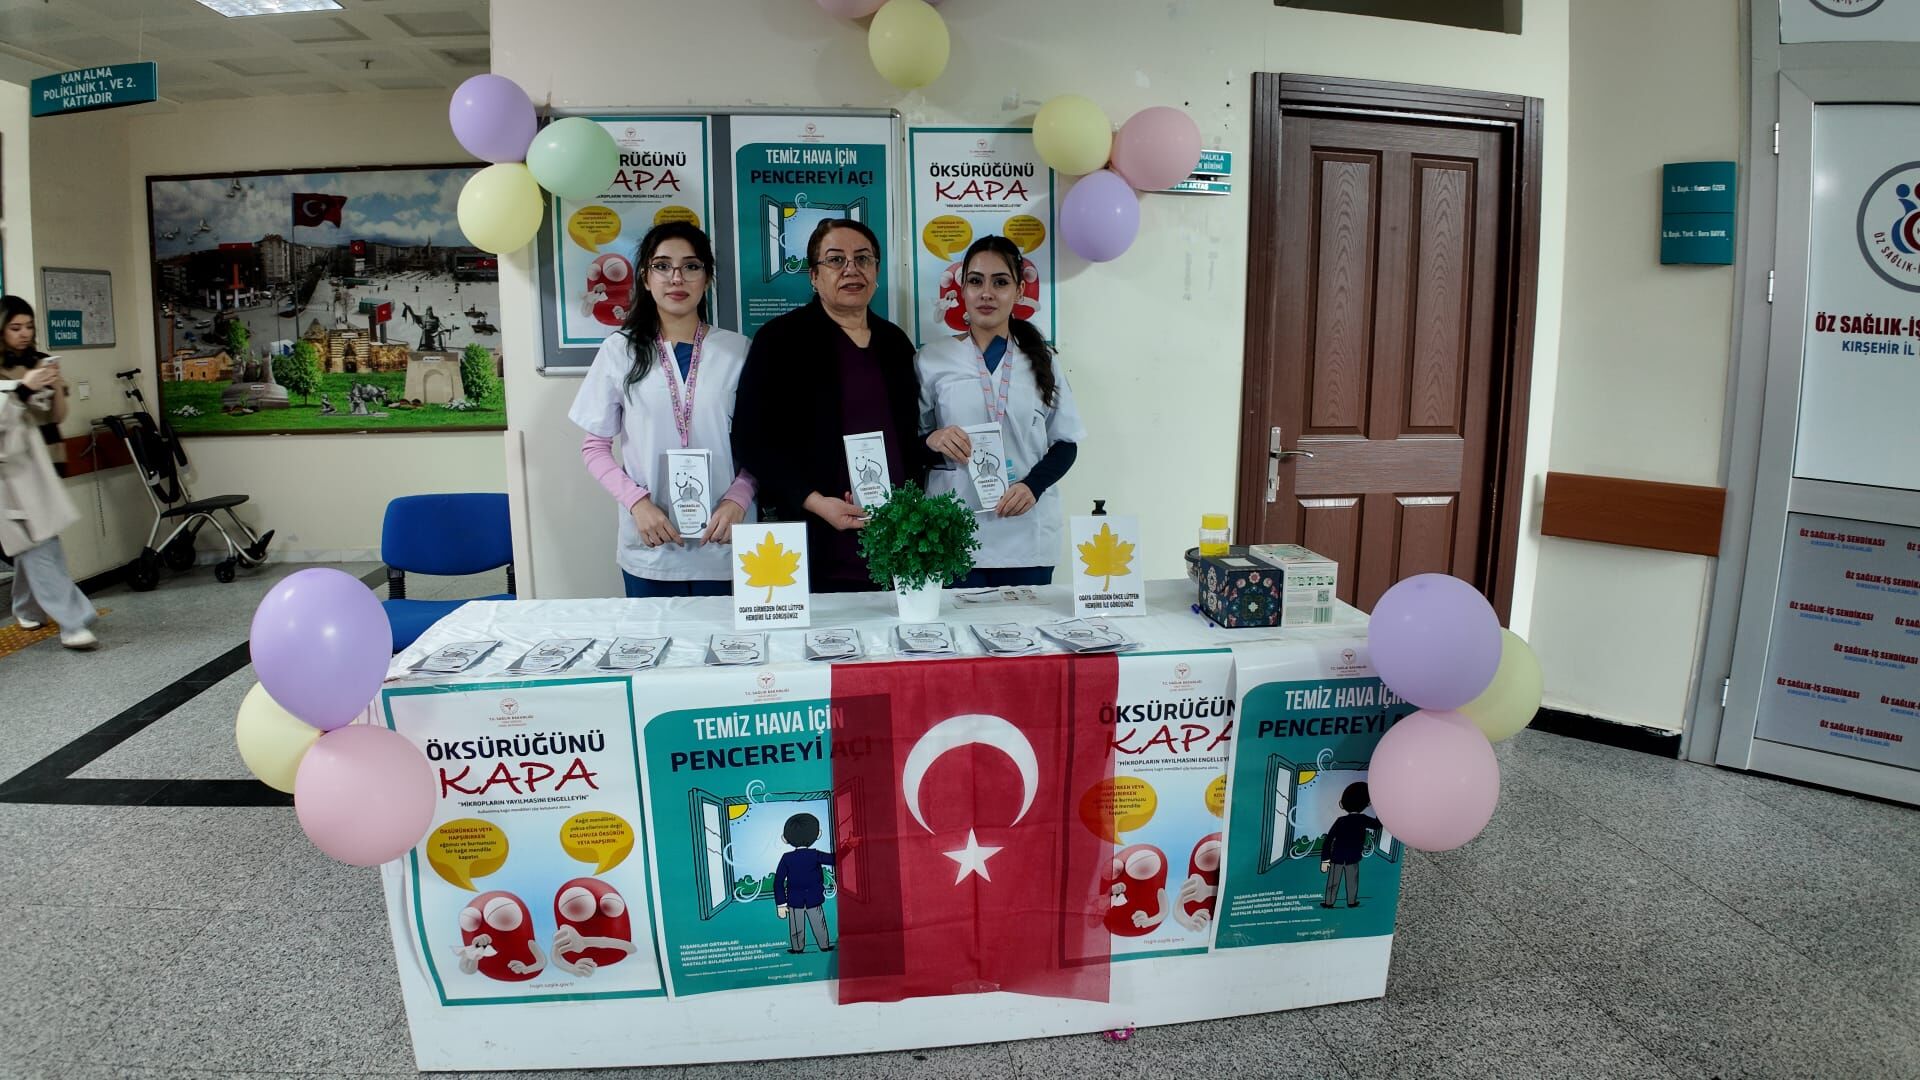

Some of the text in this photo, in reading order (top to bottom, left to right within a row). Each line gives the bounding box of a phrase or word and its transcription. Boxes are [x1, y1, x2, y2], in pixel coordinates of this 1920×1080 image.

[61, 66, 113, 85] KAN ALMA
[43, 77, 137, 101] POLİKLİNİK 1. VE 2.
[62, 92, 113, 108] KATTADIR
[619, 151, 686, 167] RÜĞÜNÜ
[765, 147, 857, 167] TEMİZ HAVA İÇİN
[750, 168, 873, 187] PENCEREYİ AÇ!
[930, 162, 1034, 177] ÖKSÜRÜĞÜNÜ
[607, 169, 681, 192] APA
[935, 179, 1029, 202] KAPA
[1873, 231, 1920, 274] ÖZ SAĞLIK-
[51, 317, 67, 328] MAVİ
[1815, 311, 1836, 333] ÖZ
[1842, 340, 1915, 356] KIRŞEHİR İL
[1799, 528, 1809, 537] ÖZ
[1810, 530, 1845, 543] SAĞLIK-İŞ
[1845, 570, 1920, 589] ÖZ SAĞLIK-İŞ SENDİK
[1789, 600, 1798, 610] ÖZ
[1799, 603, 1835, 616] SAĞLIK-İŞ
[1895, 616, 1905, 626] ÖZ
[1833, 642, 1842, 652] ÖZ
[1844, 645, 1879, 659] SAĞLIK-İŞ
[1777, 677, 1786, 686] ÖZ
[1787, 679, 1822, 693] SAĞLIK-İŞ
[1285, 685, 1331, 710] TEMİZ
[1334, 686, 1374, 708] HAVA
[1880, 695, 1920, 710] ÖZ SAĞLIK-
[1099, 696, 1236, 725] ÖKSÜRÜĞÜN
[693, 704, 844, 741] TEMİZ HAVA İÇİN
[1257, 710, 1385, 738] PENCEREYİ
[1819, 719, 1829, 729] ÖZ
[1829, 721, 1864, 736] SAĞLIK-İŞ
[426, 729, 606, 762] ÖKSÜRÜĞÜNÜ
[671, 735, 823, 773] PENCEREYİ
[439, 757, 599, 799] KAPA
[506, 796, 547, 805] YAYILMASINI
